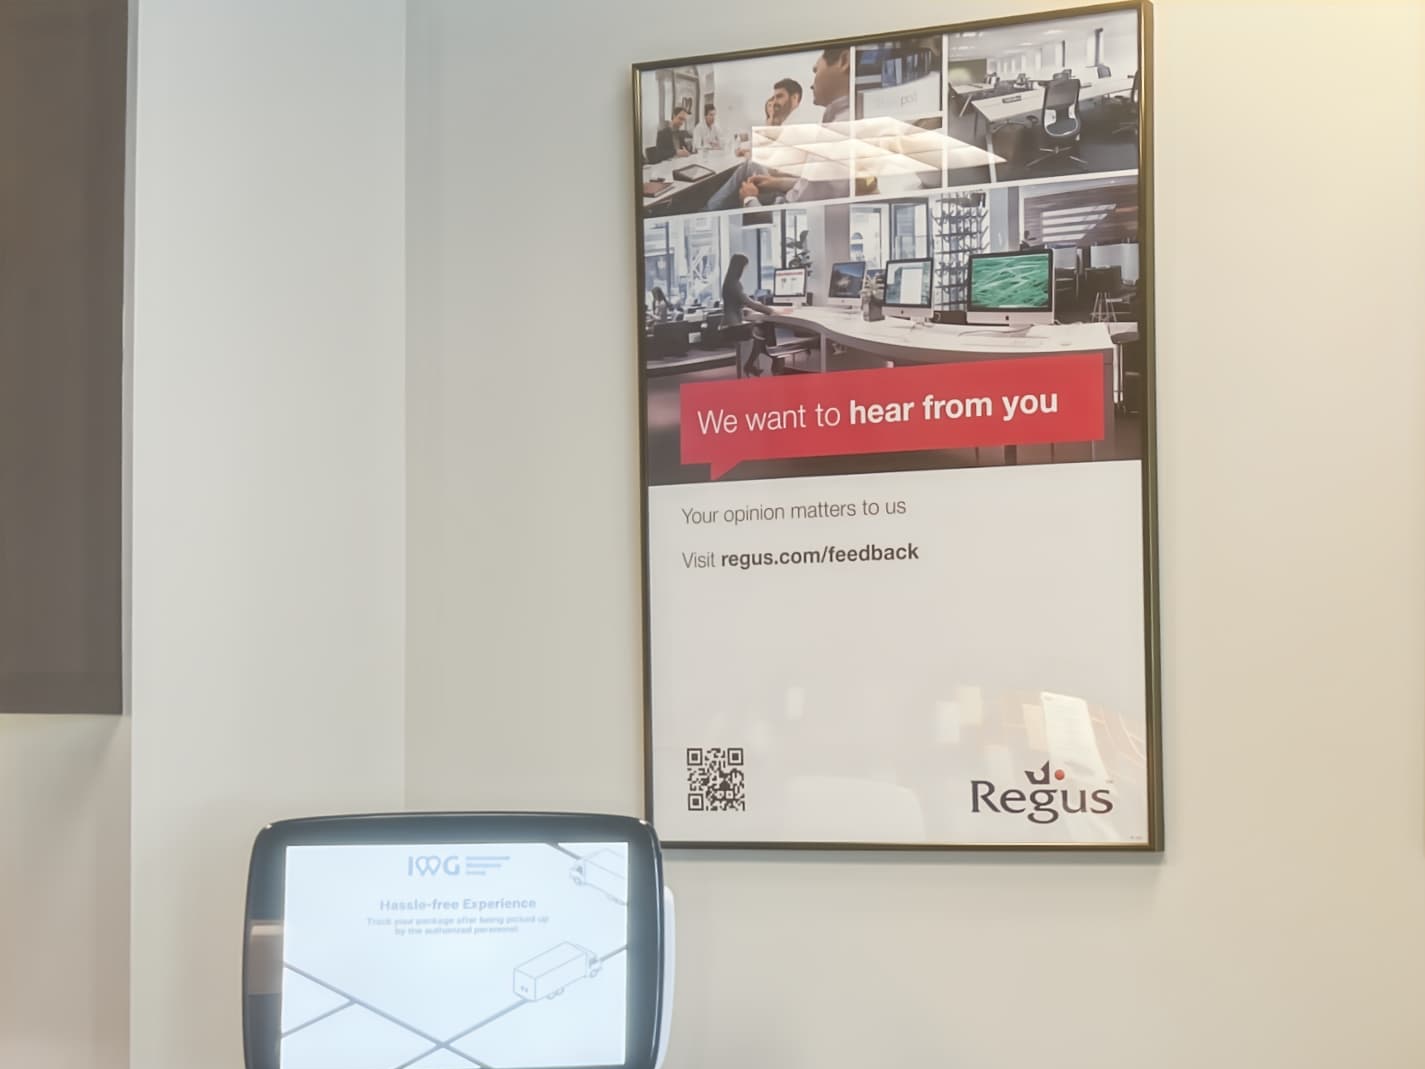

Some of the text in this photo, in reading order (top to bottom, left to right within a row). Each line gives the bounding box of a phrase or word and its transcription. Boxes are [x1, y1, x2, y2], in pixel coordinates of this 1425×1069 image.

[697, 393, 1059, 435] We want to hear from you
[681, 499, 907, 527] Your opinion matters to us
[681, 542, 920, 571] Visit regus.com/feedback
[971, 778, 1114, 824] Regus
[407, 855, 461, 877] IWG
[462, 897, 537, 912] Experience
